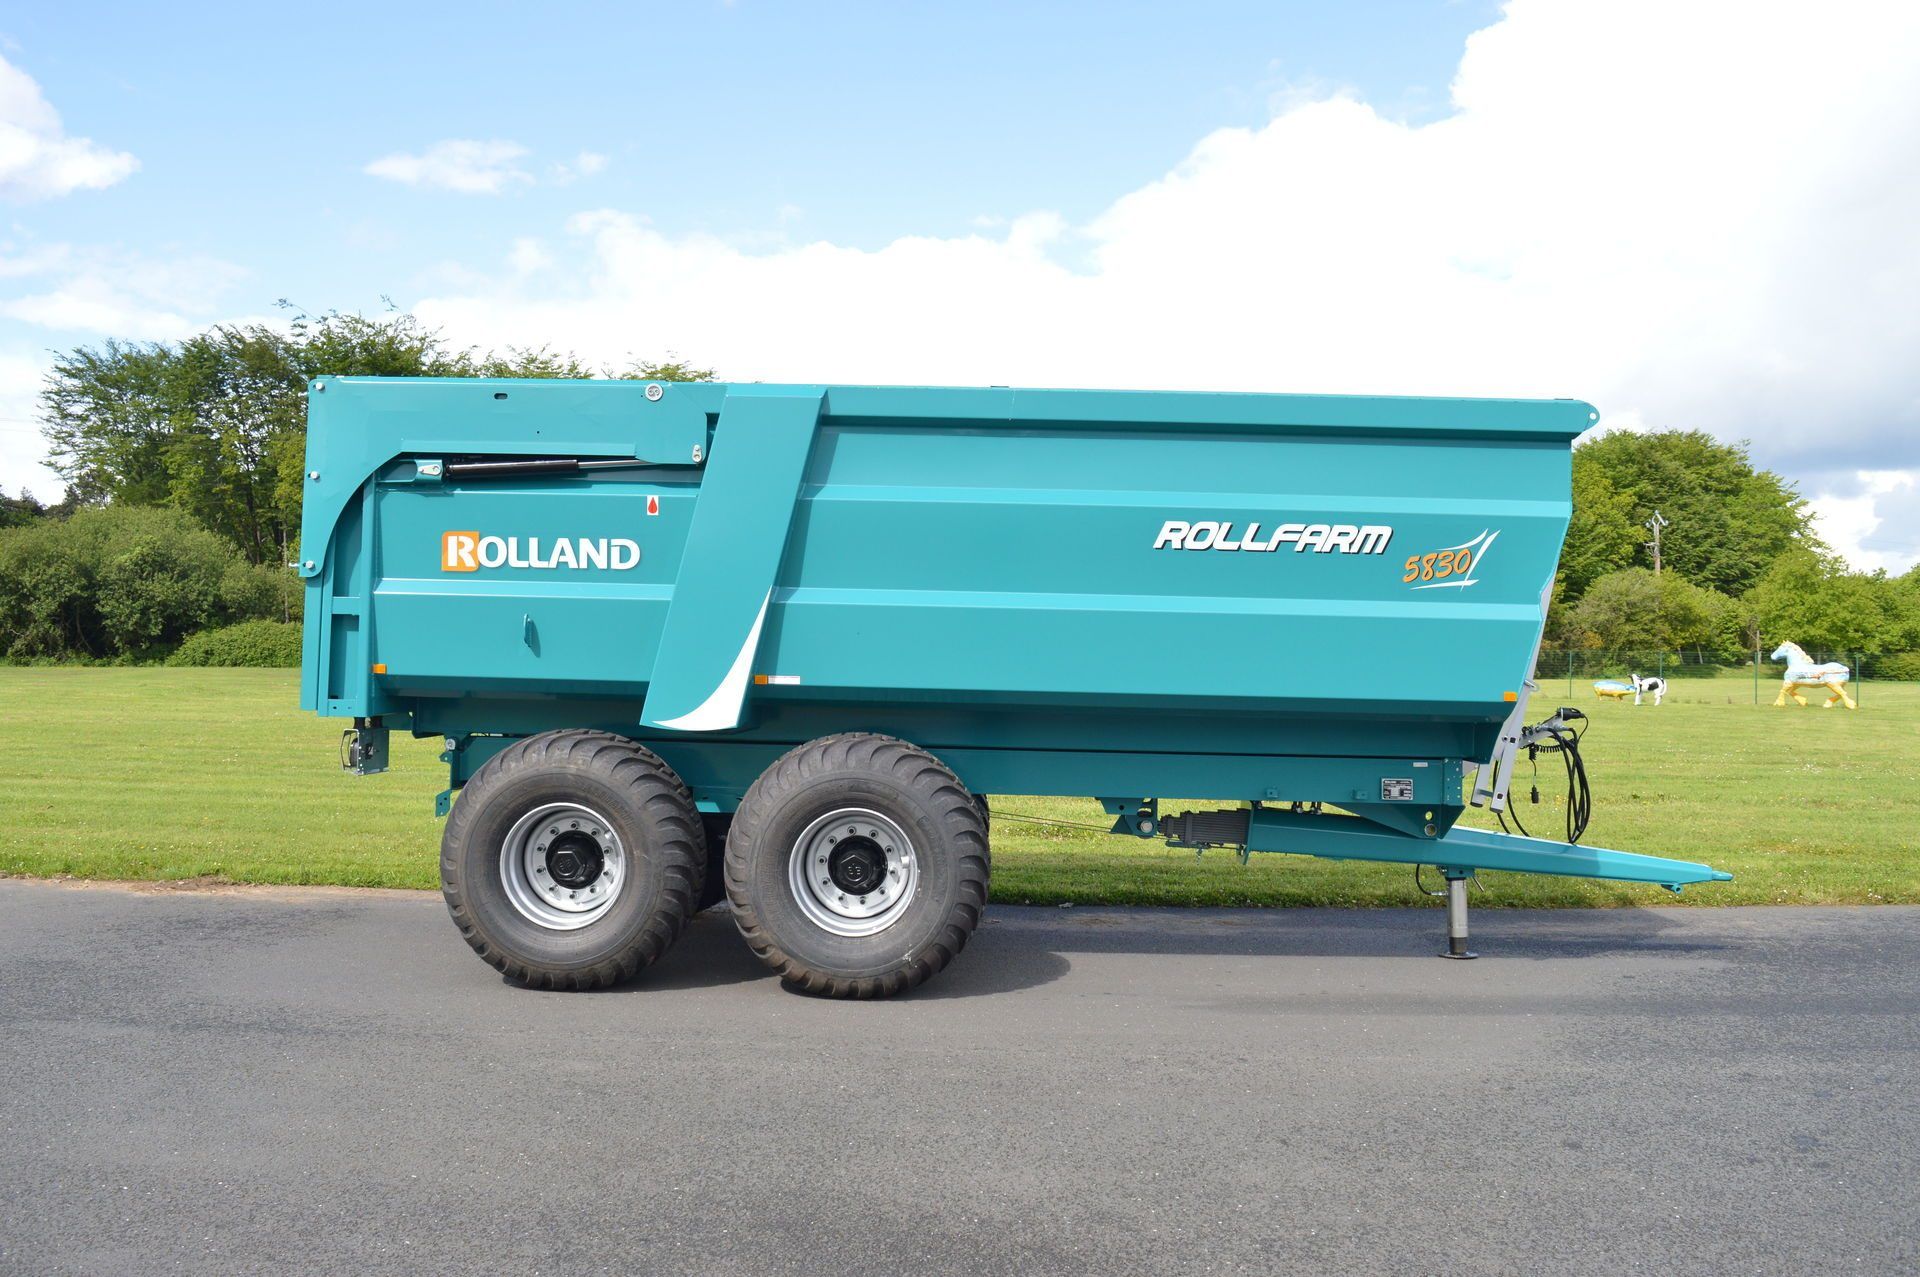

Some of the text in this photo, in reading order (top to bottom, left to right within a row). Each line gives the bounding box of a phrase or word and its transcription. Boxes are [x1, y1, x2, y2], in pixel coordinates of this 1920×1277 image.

[447, 535, 641, 570] ROLLAND
[1153, 521, 1394, 554] ROLLFARM
[1403, 548, 1472, 583] 5830
